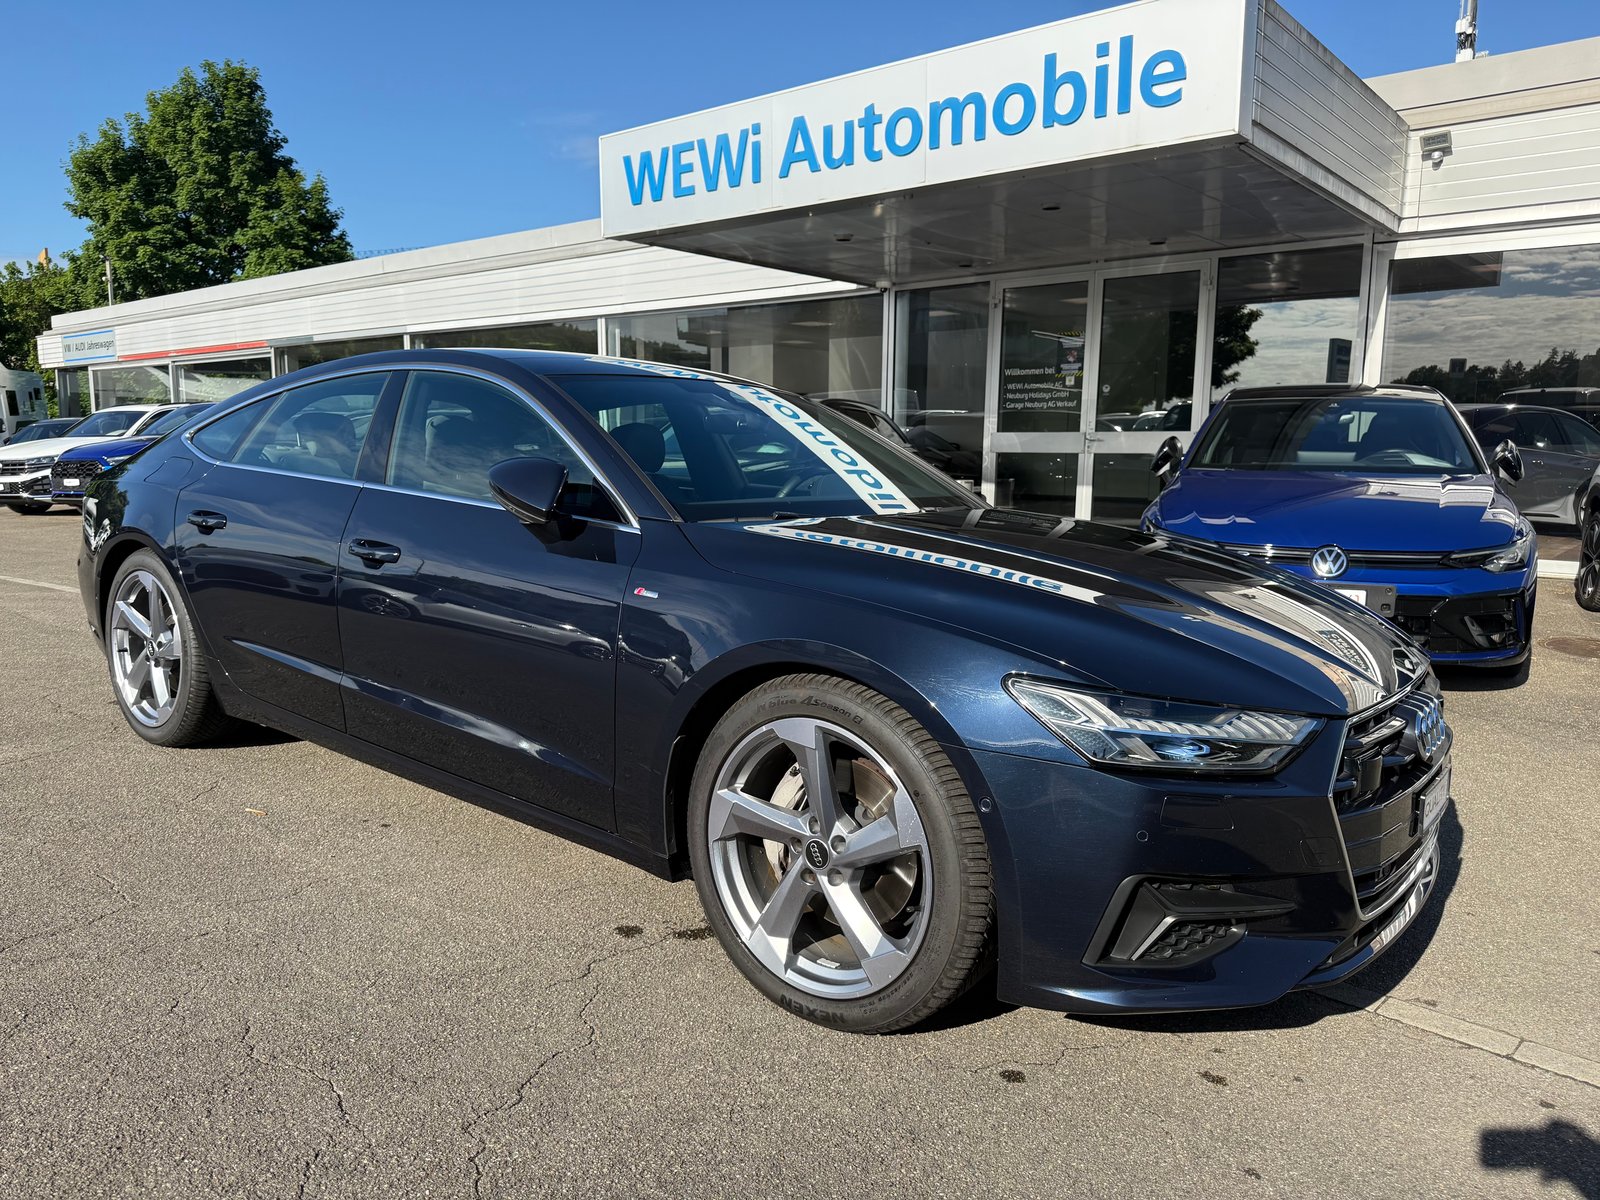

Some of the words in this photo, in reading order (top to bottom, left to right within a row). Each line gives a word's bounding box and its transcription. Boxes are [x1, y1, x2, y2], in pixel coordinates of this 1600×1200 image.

[622, 122, 761, 206] WEWi
[778, 34, 1188, 178] Automobile
[64, 343, 72, 353] VW
[75, 341, 86, 351] AUDI
[87, 340, 114, 351] Jahreswagen
[1004, 367, 1044, 376] Willkommen
[1044, 366, 1056, 374] bei
[1024, 382, 1054, 390] Automobile
[1006, 392, 1029, 400] Neuburg
[1029, 391, 1052, 400] Holidays
[1052, 390, 1070, 398] GmbH
[1006, 402, 1024, 410] Garage
[1024, 401, 1047, 409] Neuburg
[1047, 400, 1056, 408] AG
[1056, 400, 1077, 408] Verkauf
[779, 993, 846, 1025] NEXEN
